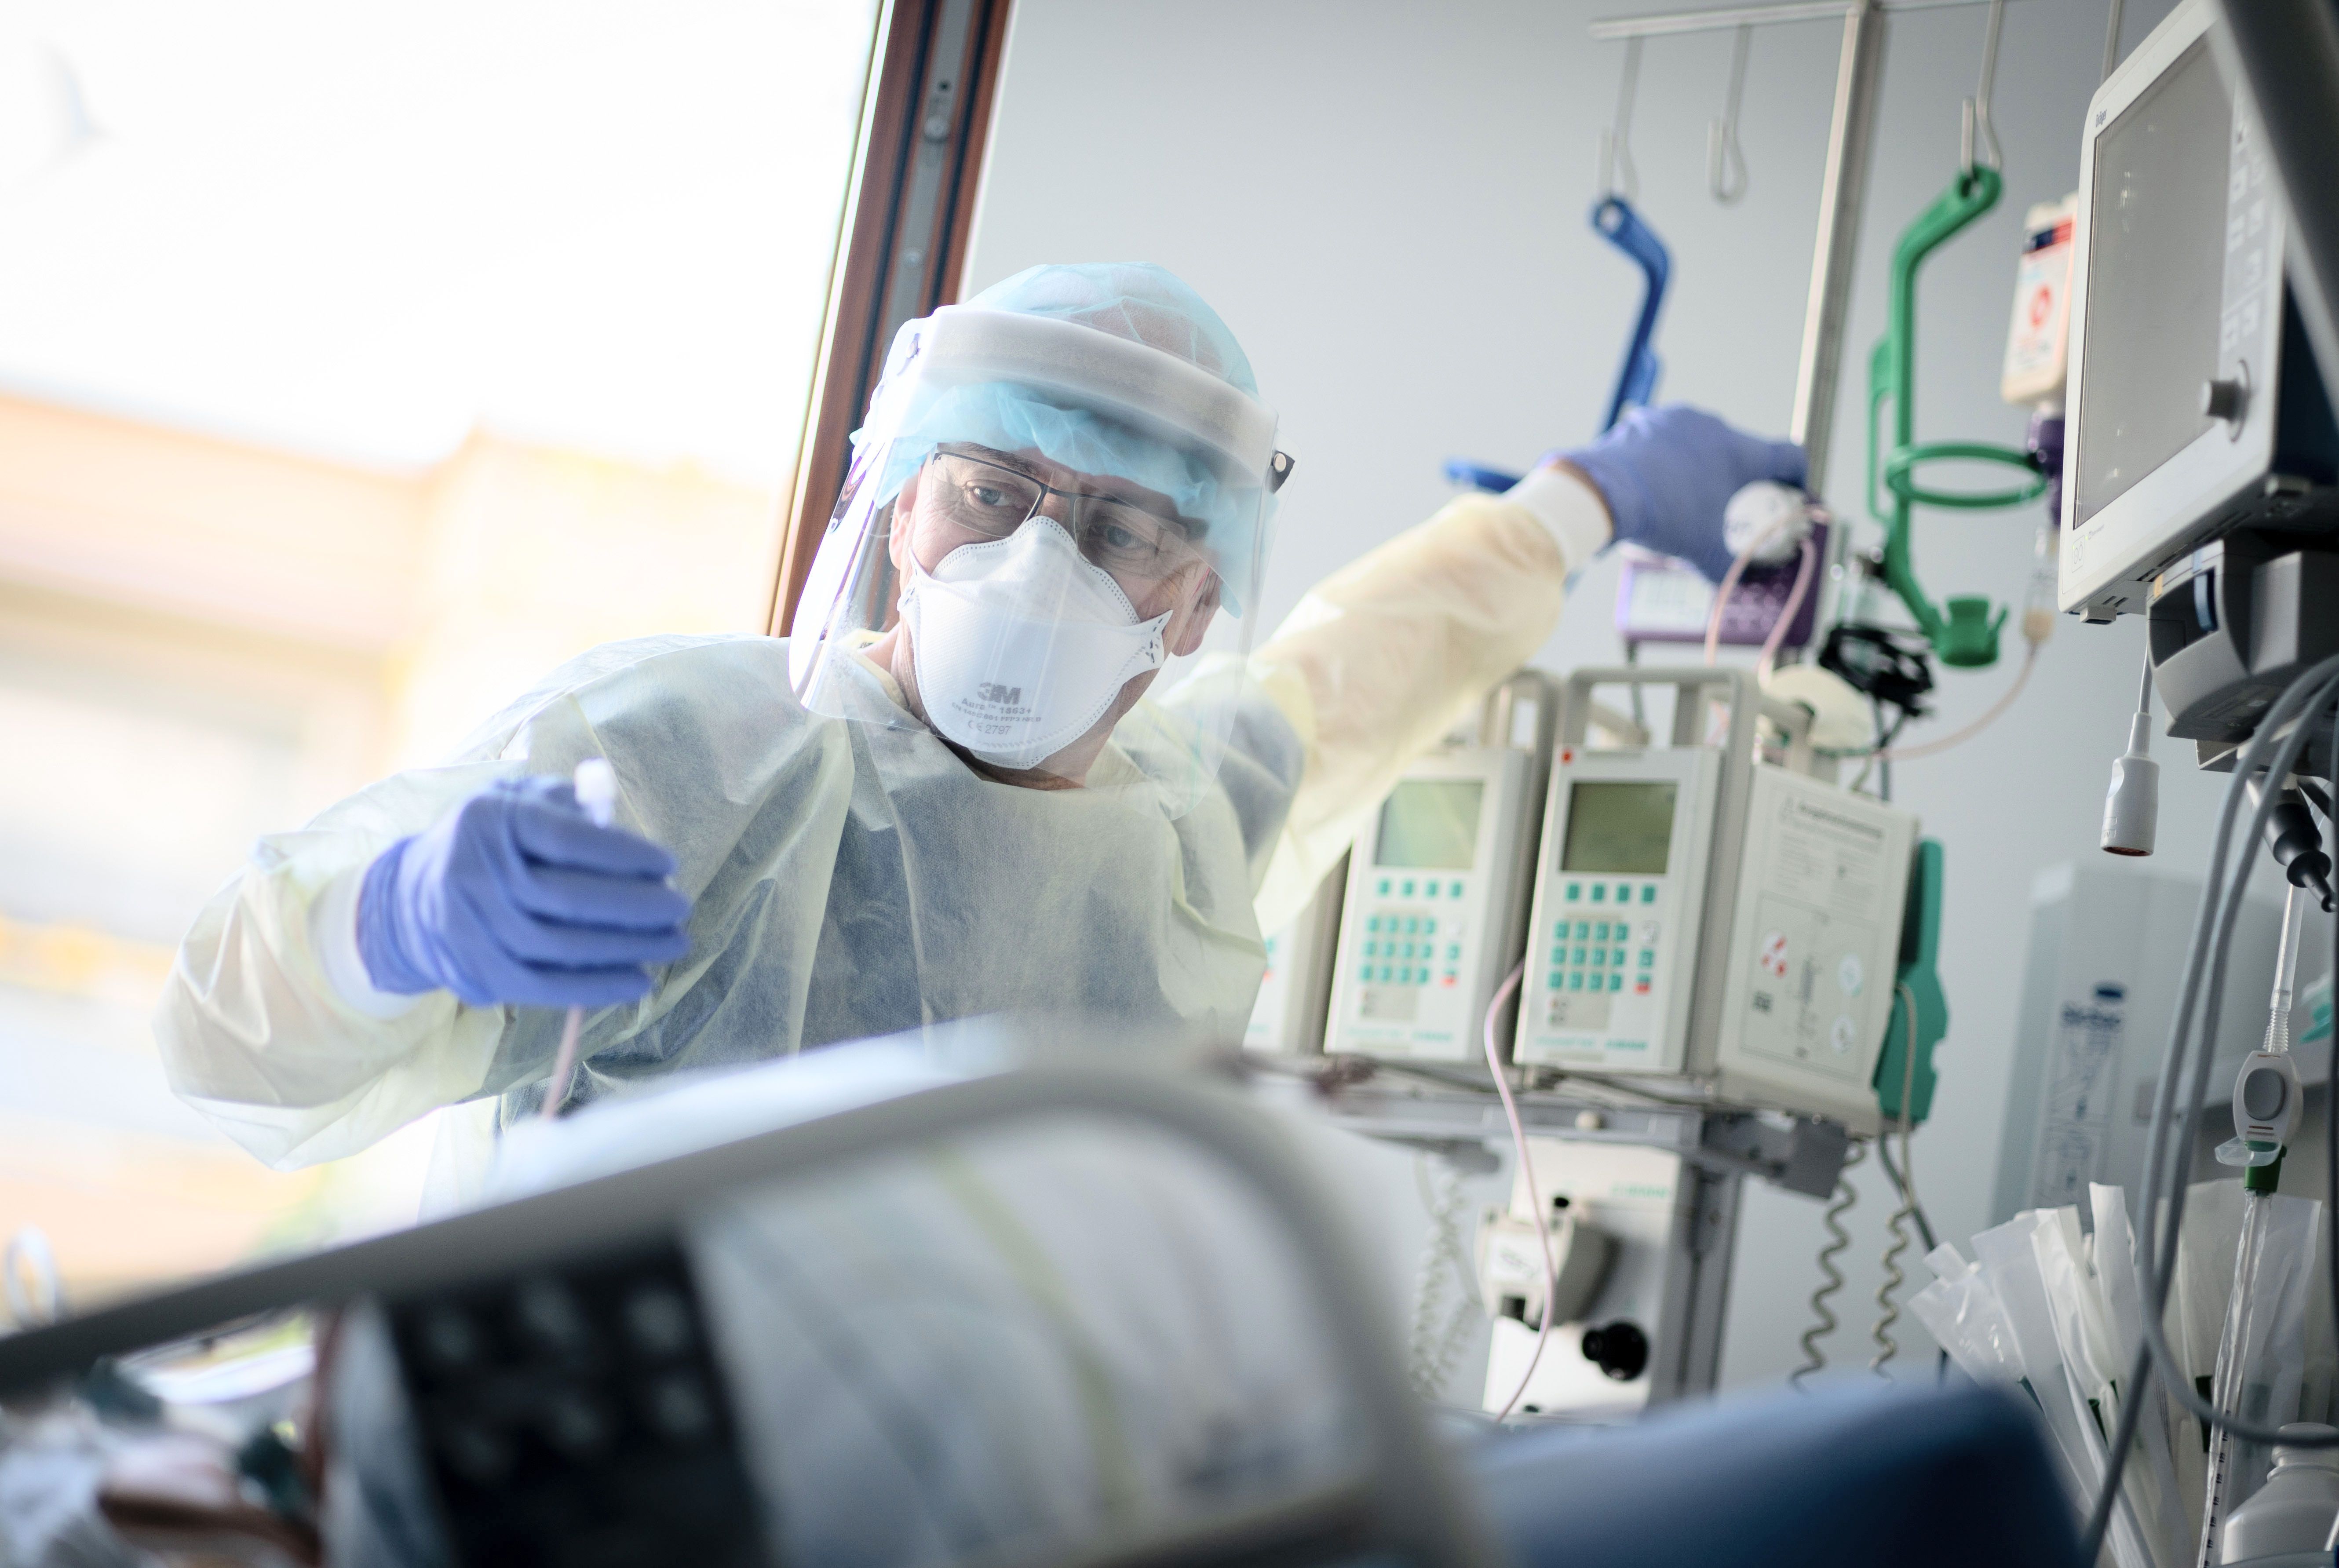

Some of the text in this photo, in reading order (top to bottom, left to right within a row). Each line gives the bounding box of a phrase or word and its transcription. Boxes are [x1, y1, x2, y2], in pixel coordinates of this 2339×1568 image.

[2095, 109, 2107, 128] Dräger
[977, 682, 1021, 704] 3M
[961, 698, 985, 710] Aura
[985, 724, 1012, 735] 2797
